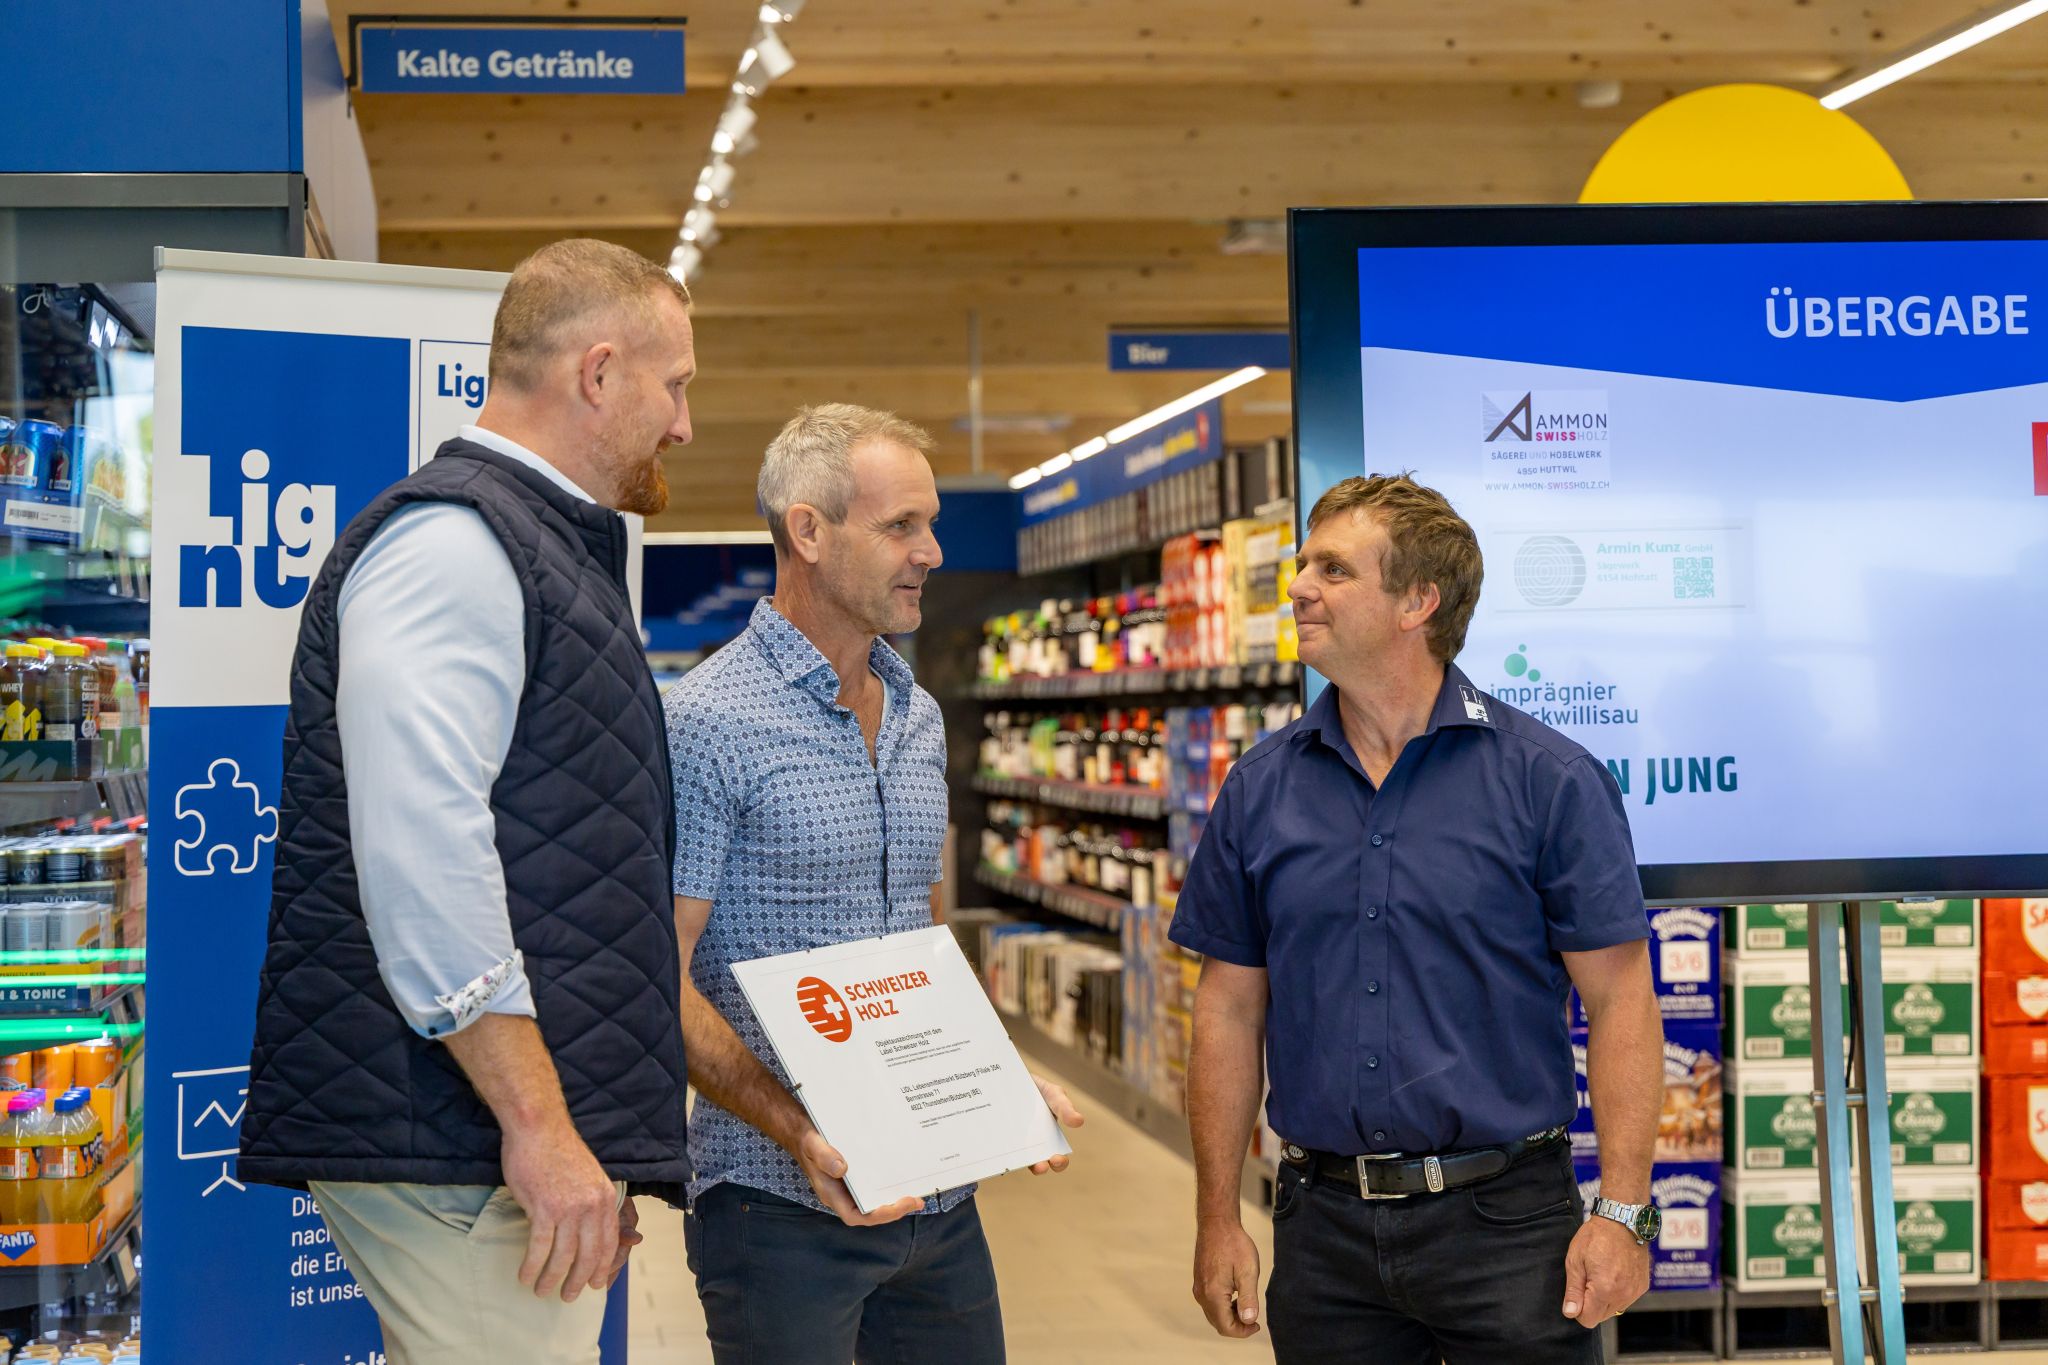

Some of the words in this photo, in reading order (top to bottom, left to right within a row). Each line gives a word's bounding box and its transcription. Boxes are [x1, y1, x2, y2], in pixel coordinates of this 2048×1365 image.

[397, 50, 480, 77] Kalte
[488, 50, 633, 78] Getränke
[1766, 286, 2029, 339] ÜBERGABE
[1127, 342, 1168, 365] Bier
[438, 362, 490, 409] Lig
[1536, 413, 1607, 429] AMMON
[1549, 450, 1602, 460] HOBELWERK
[1540, 465, 1577, 474] HUTTWIL
[1597, 541, 1640, 555] Armin
[1645, 541, 1681, 554] Kunz
[1684, 544, 1714, 553] GmbH
[1490, 682, 1617, 706] imprägnier
[1531, 705, 1639, 726] rkwillisau
[1606, 758, 1630, 795] N
[1645, 755, 1738, 805] JUNG
[23, 988, 66, 1000] TONIC
[844, 970, 931, 1001] SCHWEIZER
[855, 999, 899, 1021] HOLZ
[1772, 1002, 1811, 1023] Chan
[291, 1255, 319, 1277] die
[291, 1286, 314, 1307] ist
[319, 1283, 367, 1304] unse
